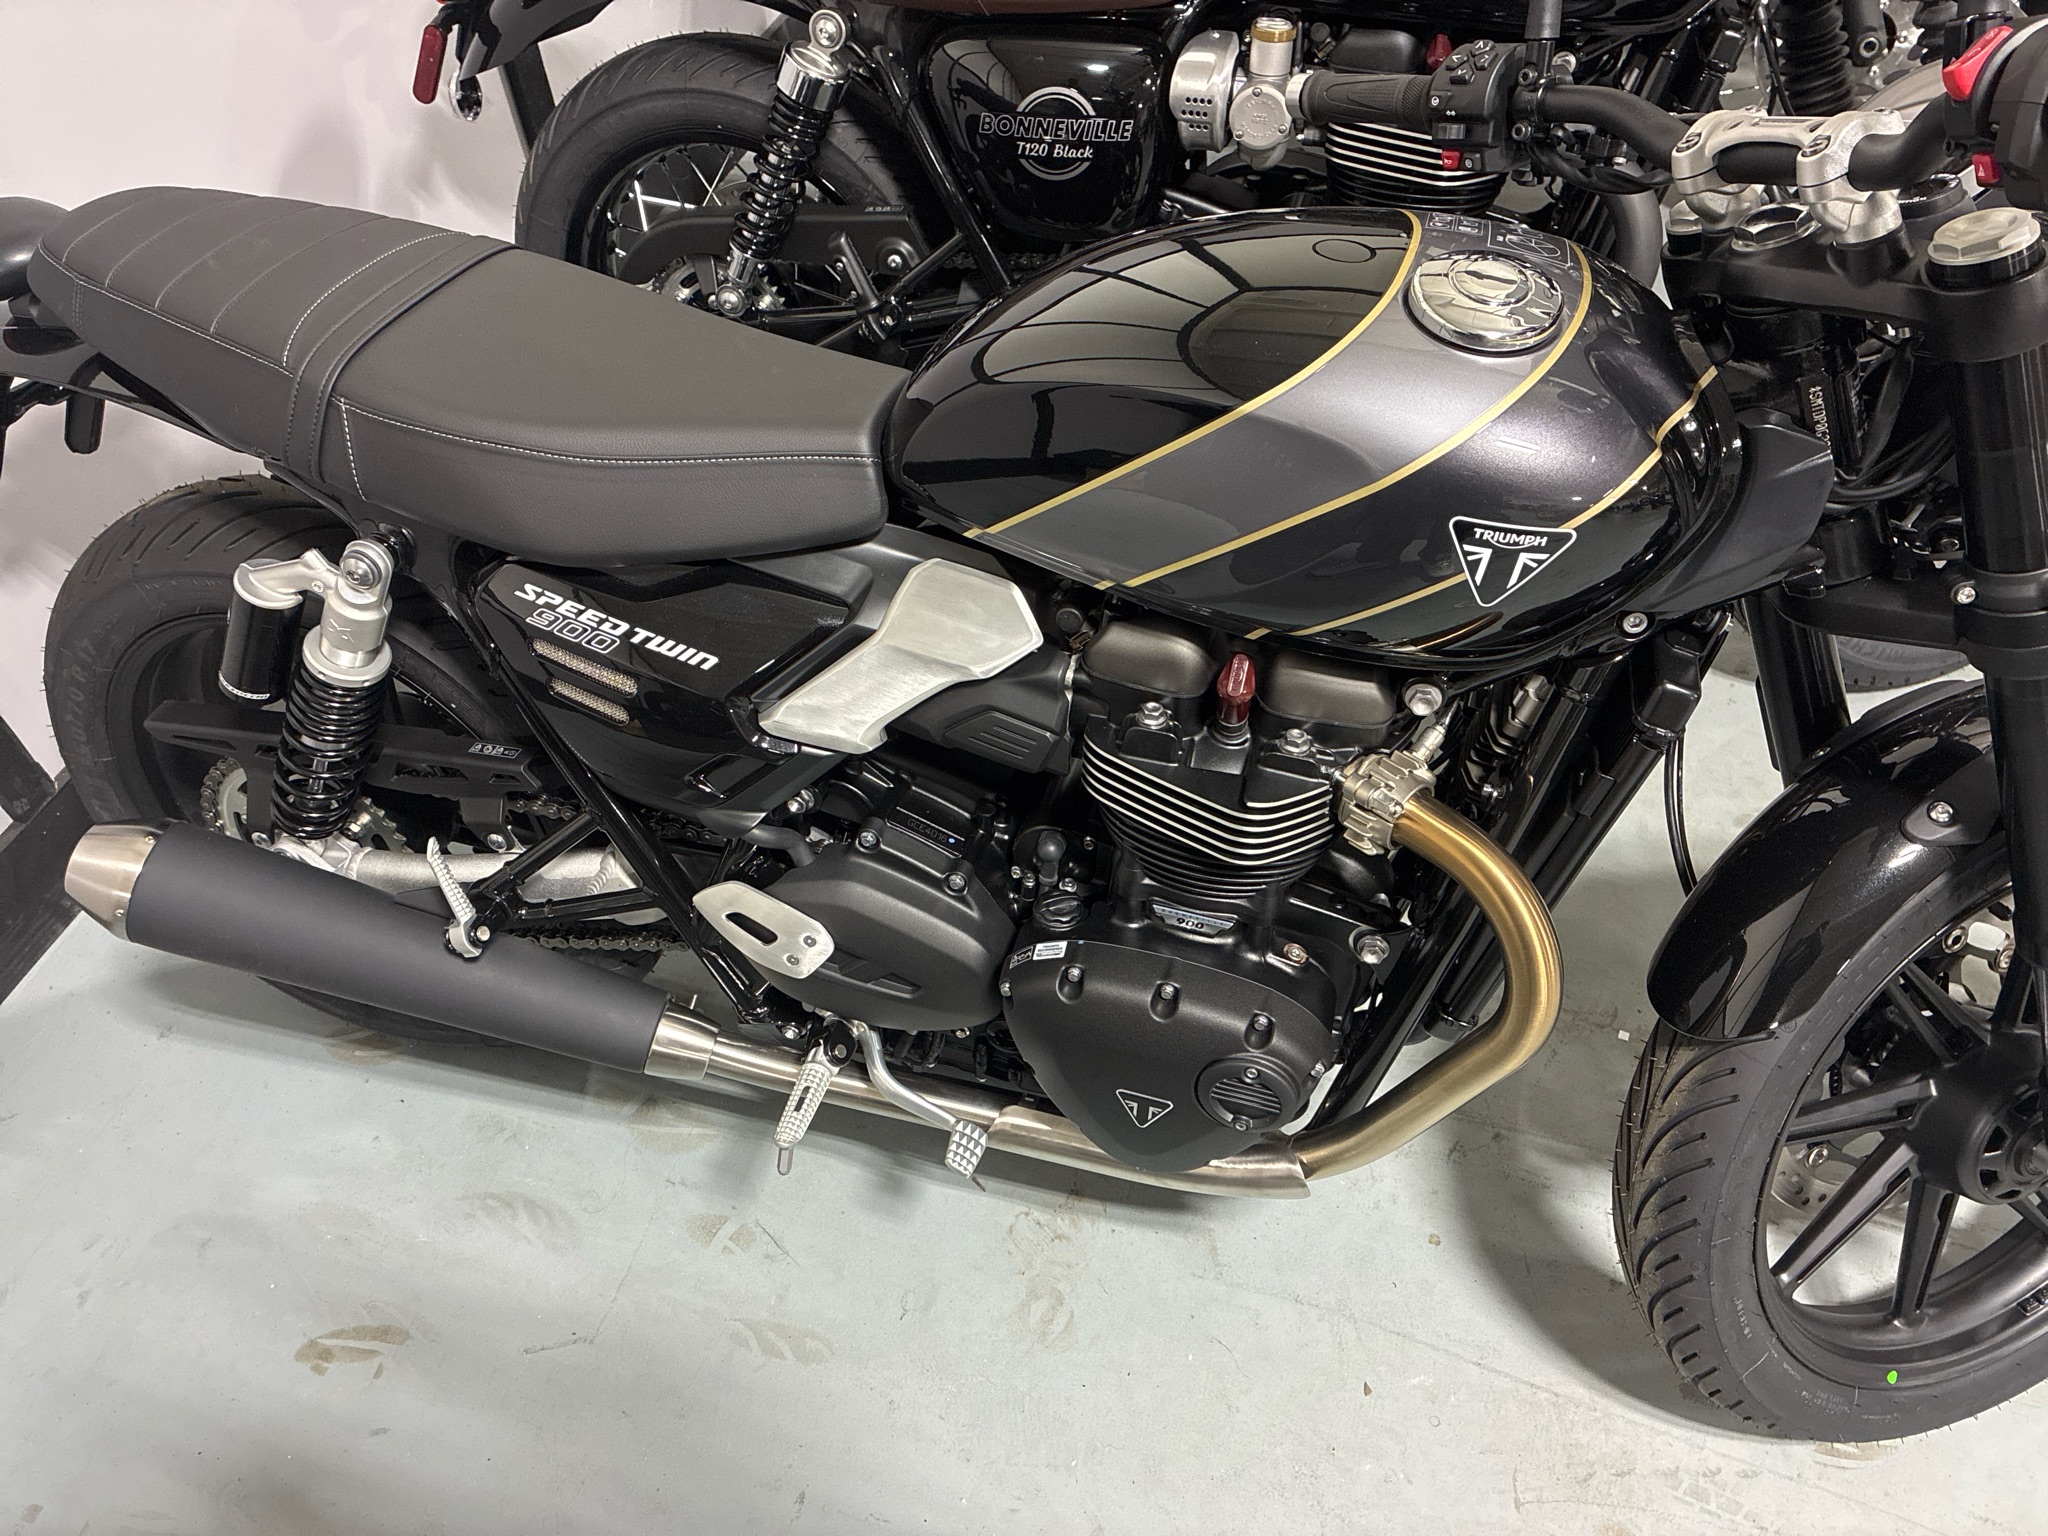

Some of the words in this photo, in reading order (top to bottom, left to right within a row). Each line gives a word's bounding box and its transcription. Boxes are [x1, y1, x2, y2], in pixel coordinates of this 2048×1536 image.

[979, 112, 1134, 142] BONNEVILLE
[1016, 141, 1048, 157] T120
[1053, 143, 1094, 159] Black
[1473, 527, 1548, 548] TRIUMPH
[514, 583, 631, 637] SPEED
[629, 627, 720, 671] TWIN
[525, 607, 621, 654] 900
[1176, 917, 1205, 930] 900
